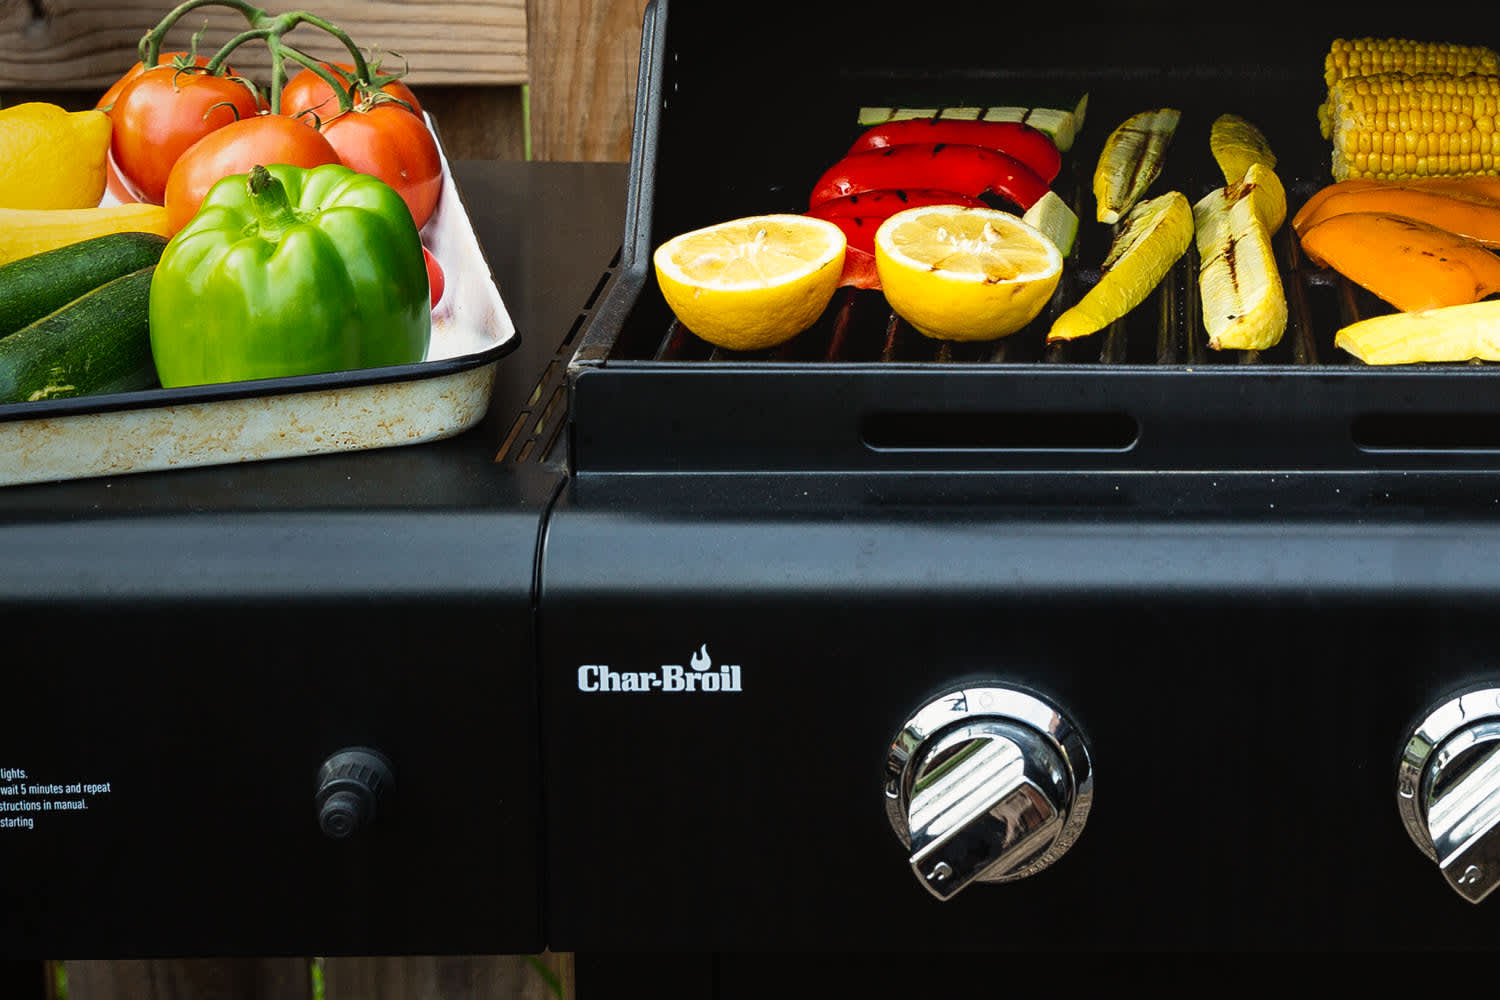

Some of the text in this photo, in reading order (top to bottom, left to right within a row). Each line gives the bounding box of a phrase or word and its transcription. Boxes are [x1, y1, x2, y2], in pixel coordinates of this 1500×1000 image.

[577, 663, 743, 692] Char-Broil
[0, 768, 28, 781] lights.
[0, 782, 111, 795] wait 5 minutes and repeat
[43, 799, 52, 810] in
[53, 798, 89, 810] manual.
[0, 816, 34, 829] starting
